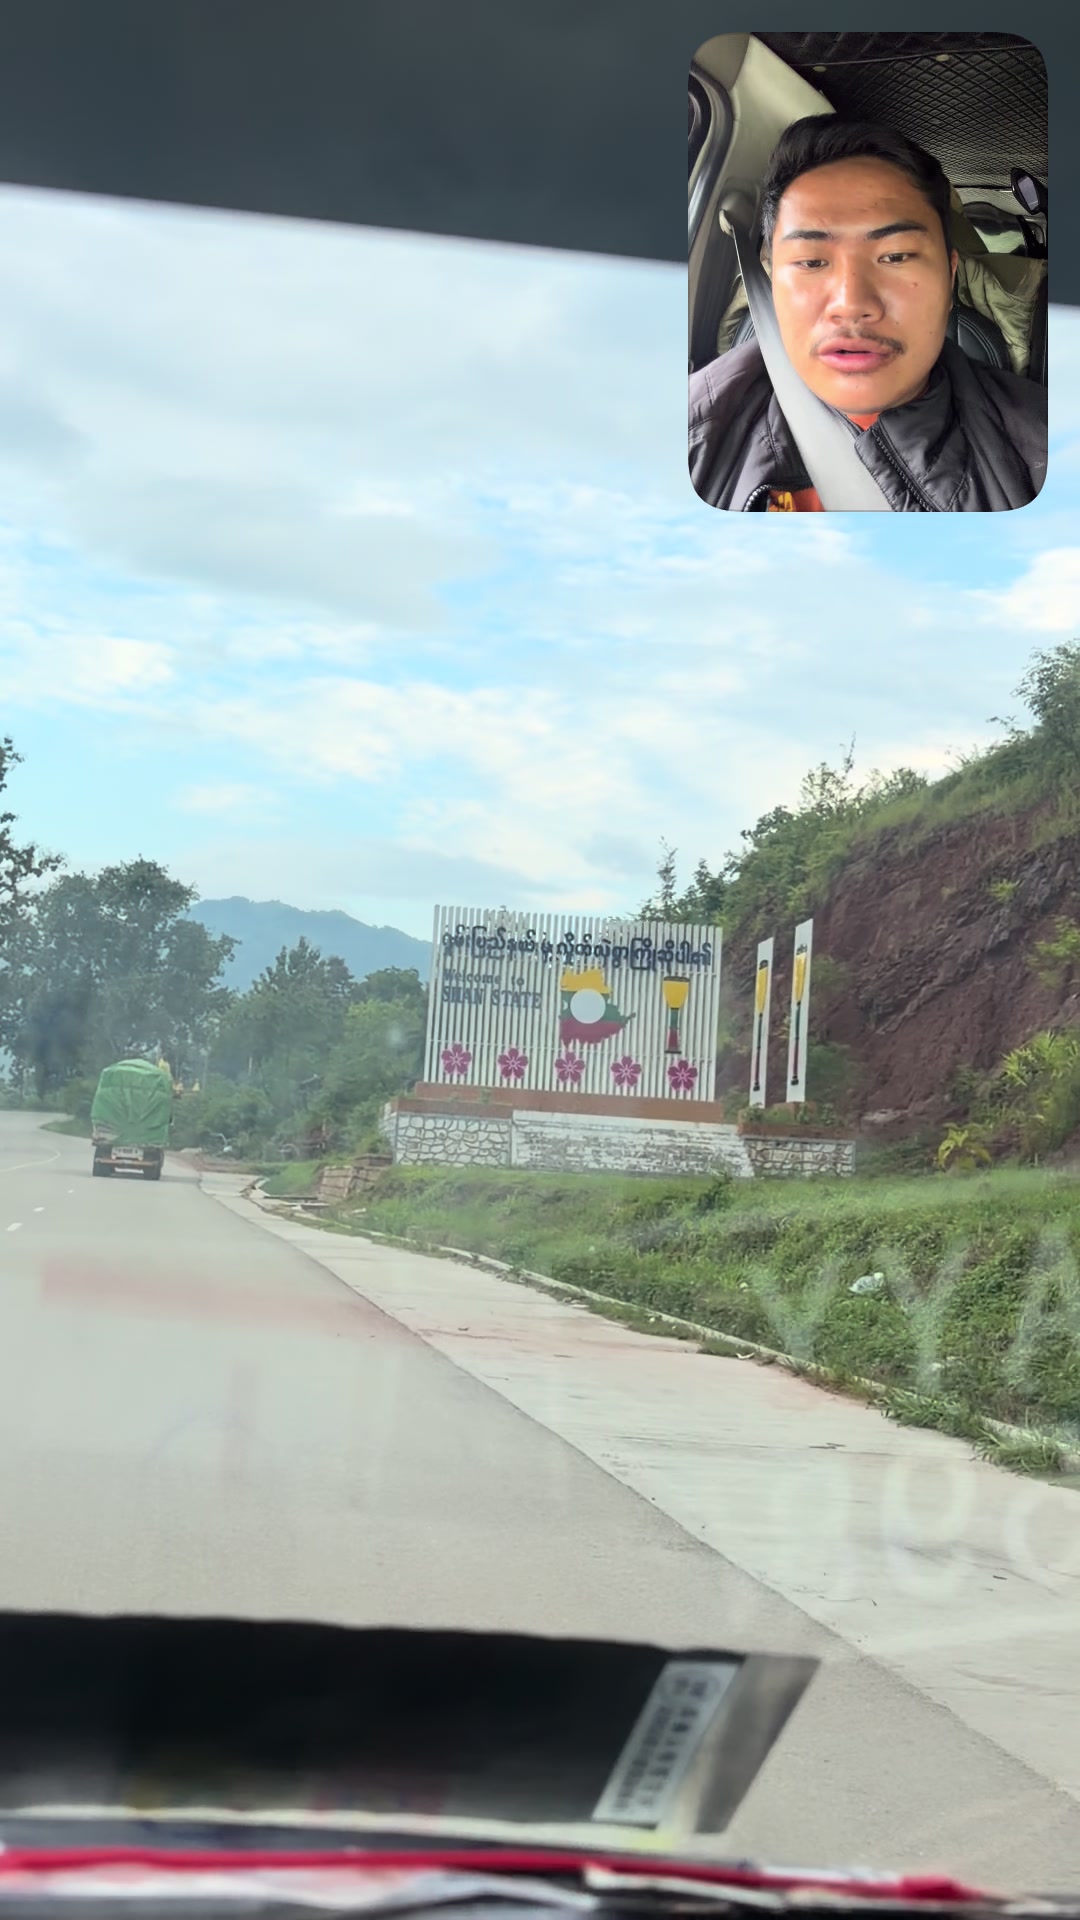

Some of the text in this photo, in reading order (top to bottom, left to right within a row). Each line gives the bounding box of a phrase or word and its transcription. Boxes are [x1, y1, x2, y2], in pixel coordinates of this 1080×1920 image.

[443, 968, 525, 987] Welcome to
[442, 985, 541, 1008] SHAN STATE
